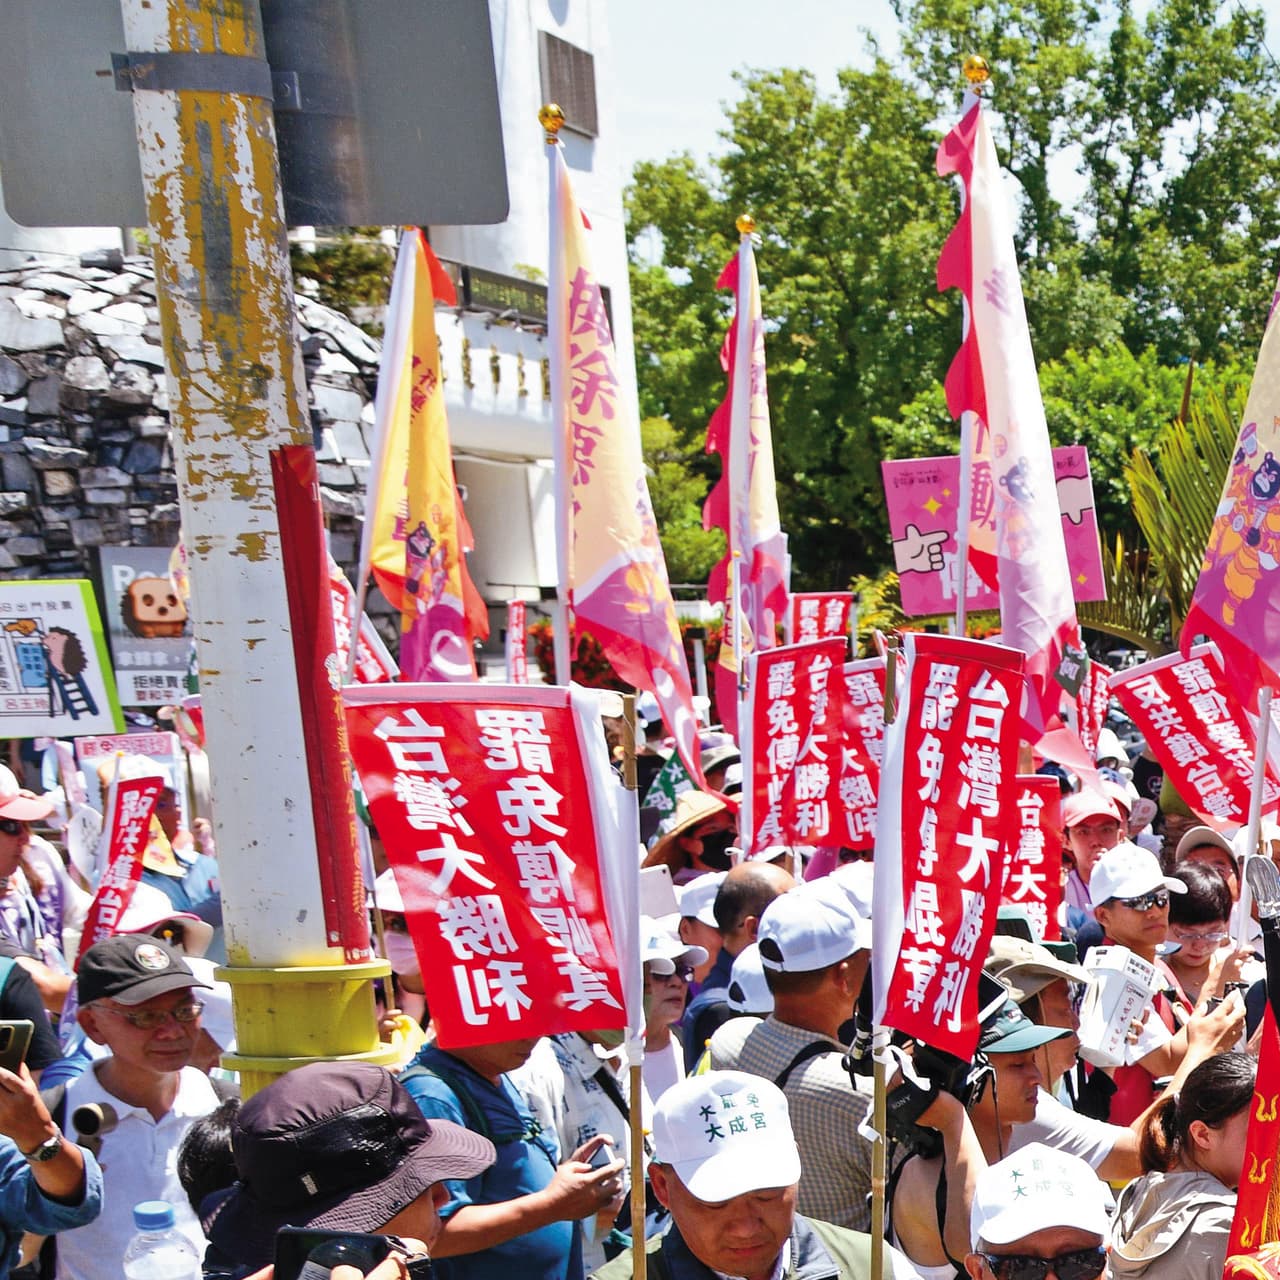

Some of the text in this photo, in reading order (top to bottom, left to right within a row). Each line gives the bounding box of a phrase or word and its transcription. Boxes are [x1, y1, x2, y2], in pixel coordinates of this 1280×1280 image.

[795, 654, 834, 837] 台灣大勝利
[901, 661, 959, 1014] 罷免傅崐萁
[933, 670, 1010, 1034] 台灣大勝利
[1010, 788, 1048, 941] 台灣大勝
[705, 1112, 767, 1143] 大成宮
